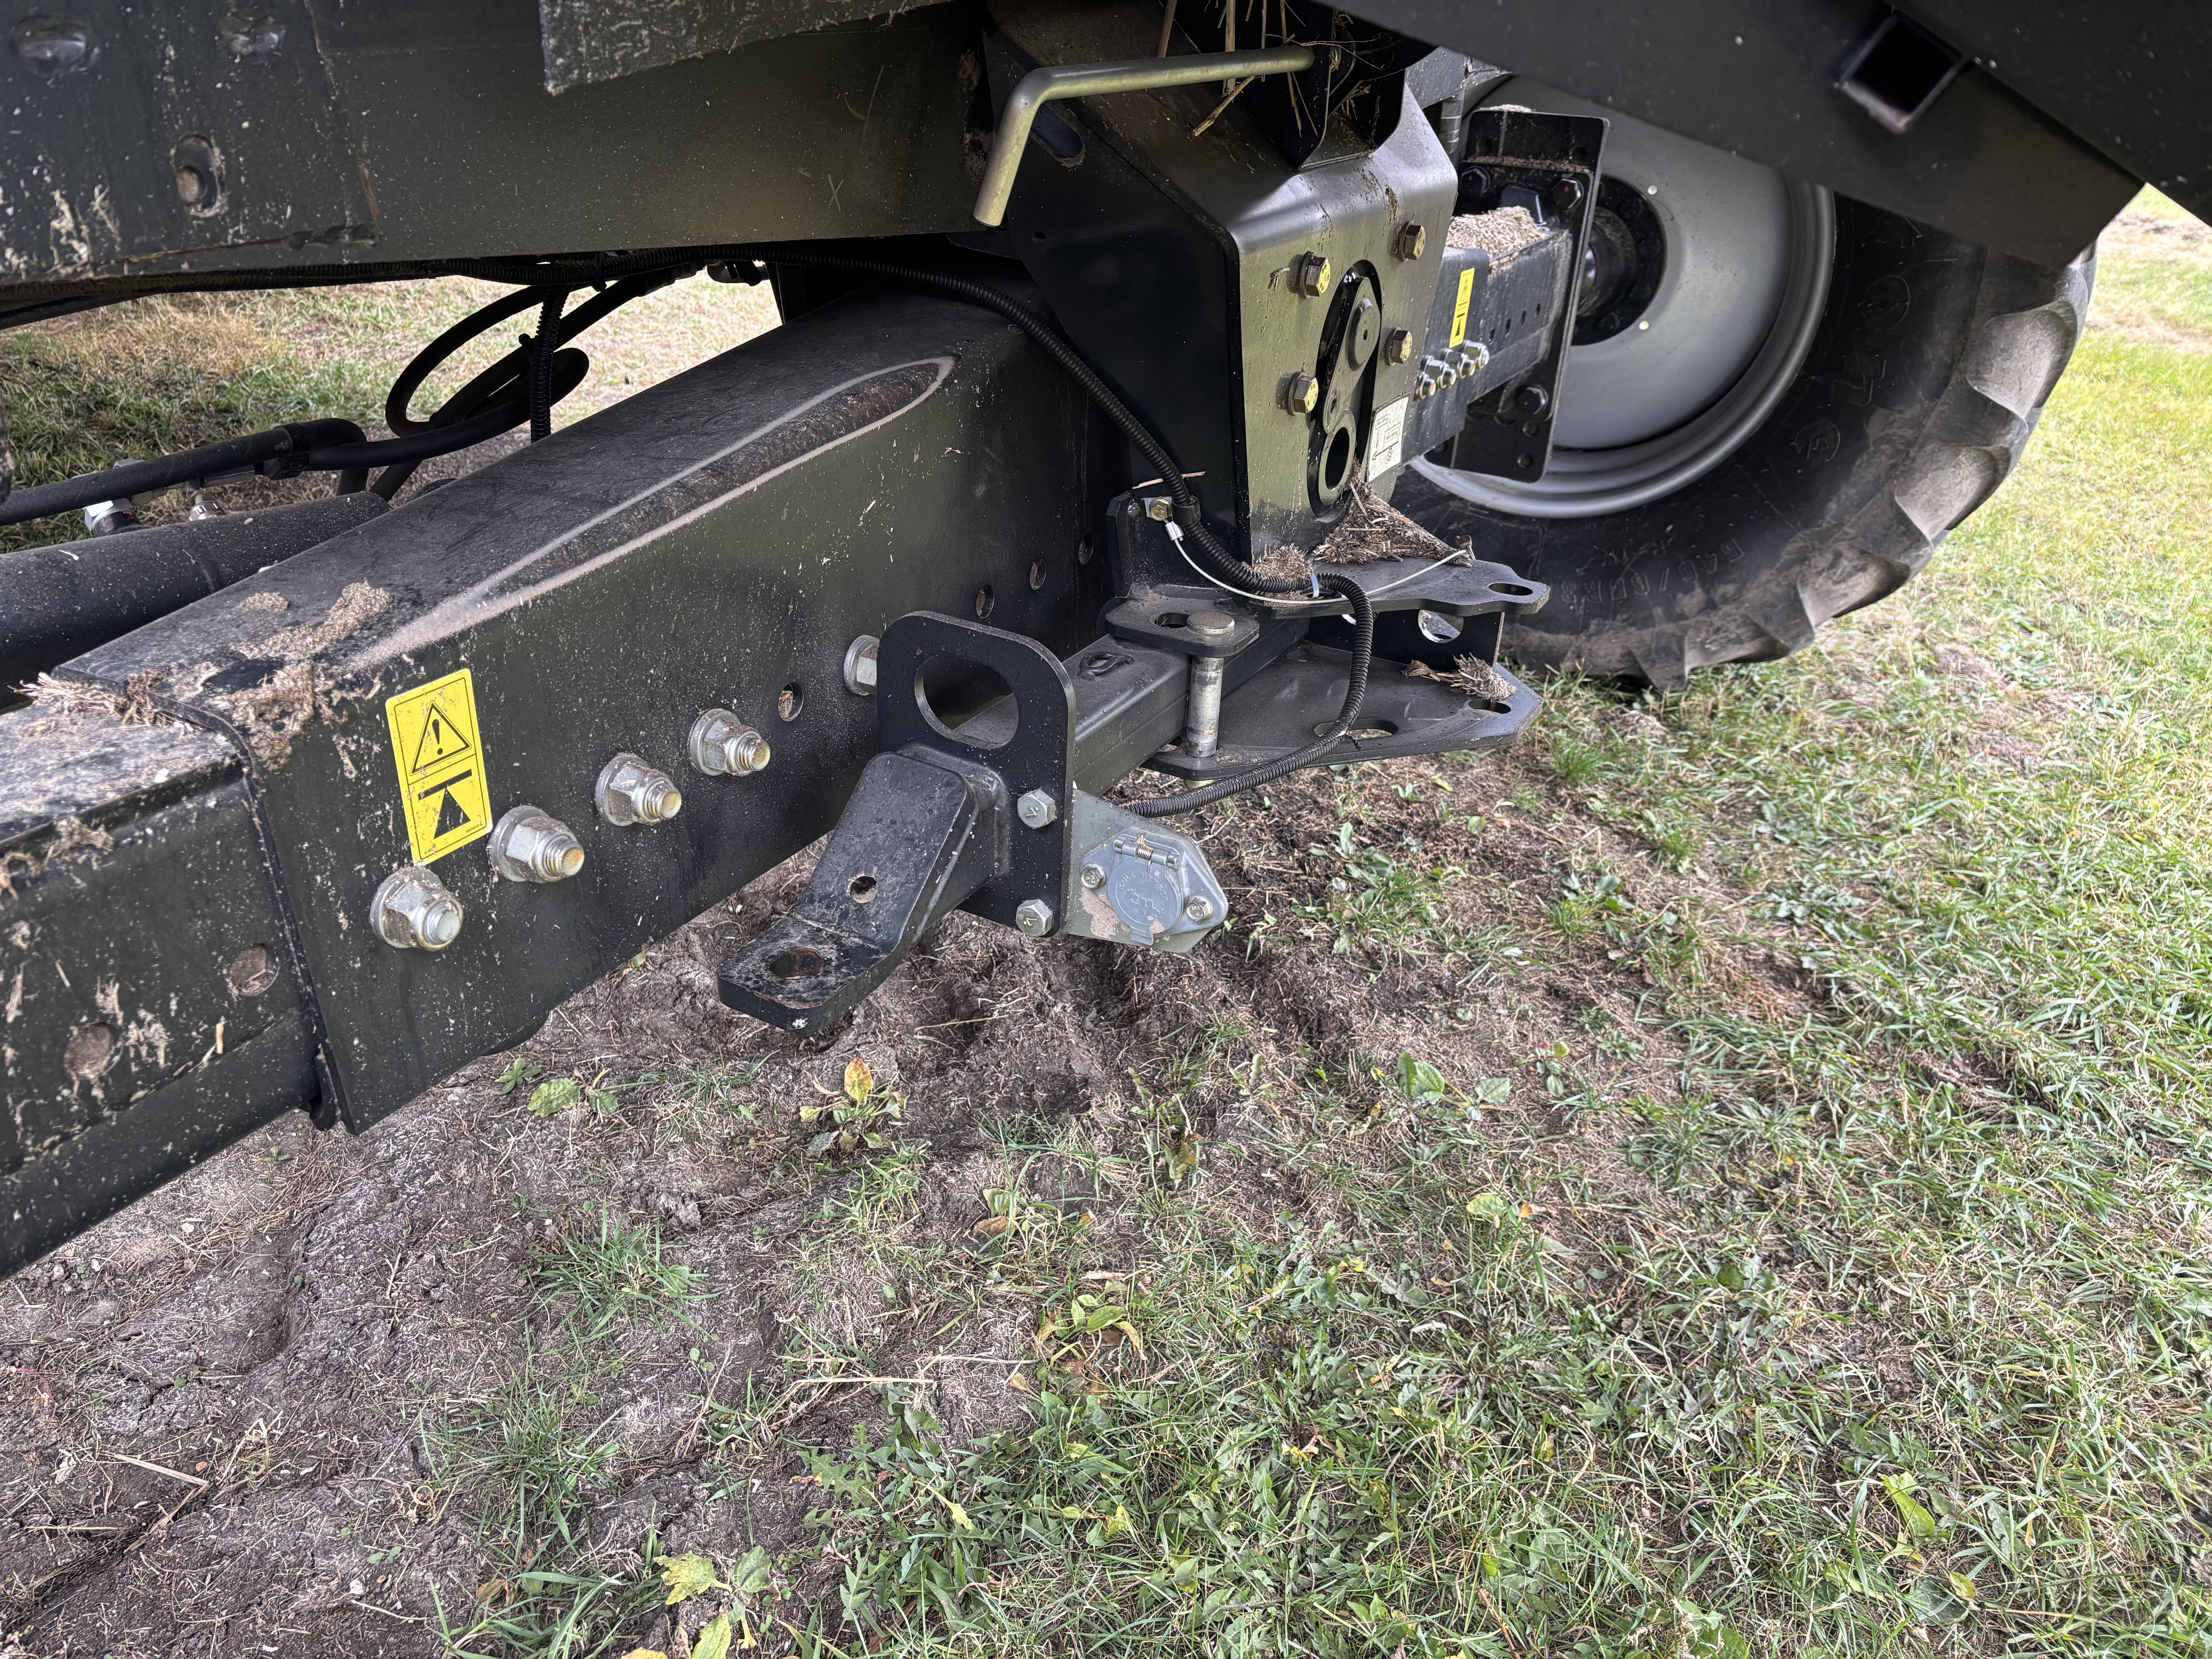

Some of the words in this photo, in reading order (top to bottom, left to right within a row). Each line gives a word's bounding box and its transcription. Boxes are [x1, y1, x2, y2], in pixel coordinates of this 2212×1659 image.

[1547, 538, 1745, 603] 540/65R3
[1118, 871, 1136, 888] COLE
[1141, 872, 1168, 902] HERSEE
